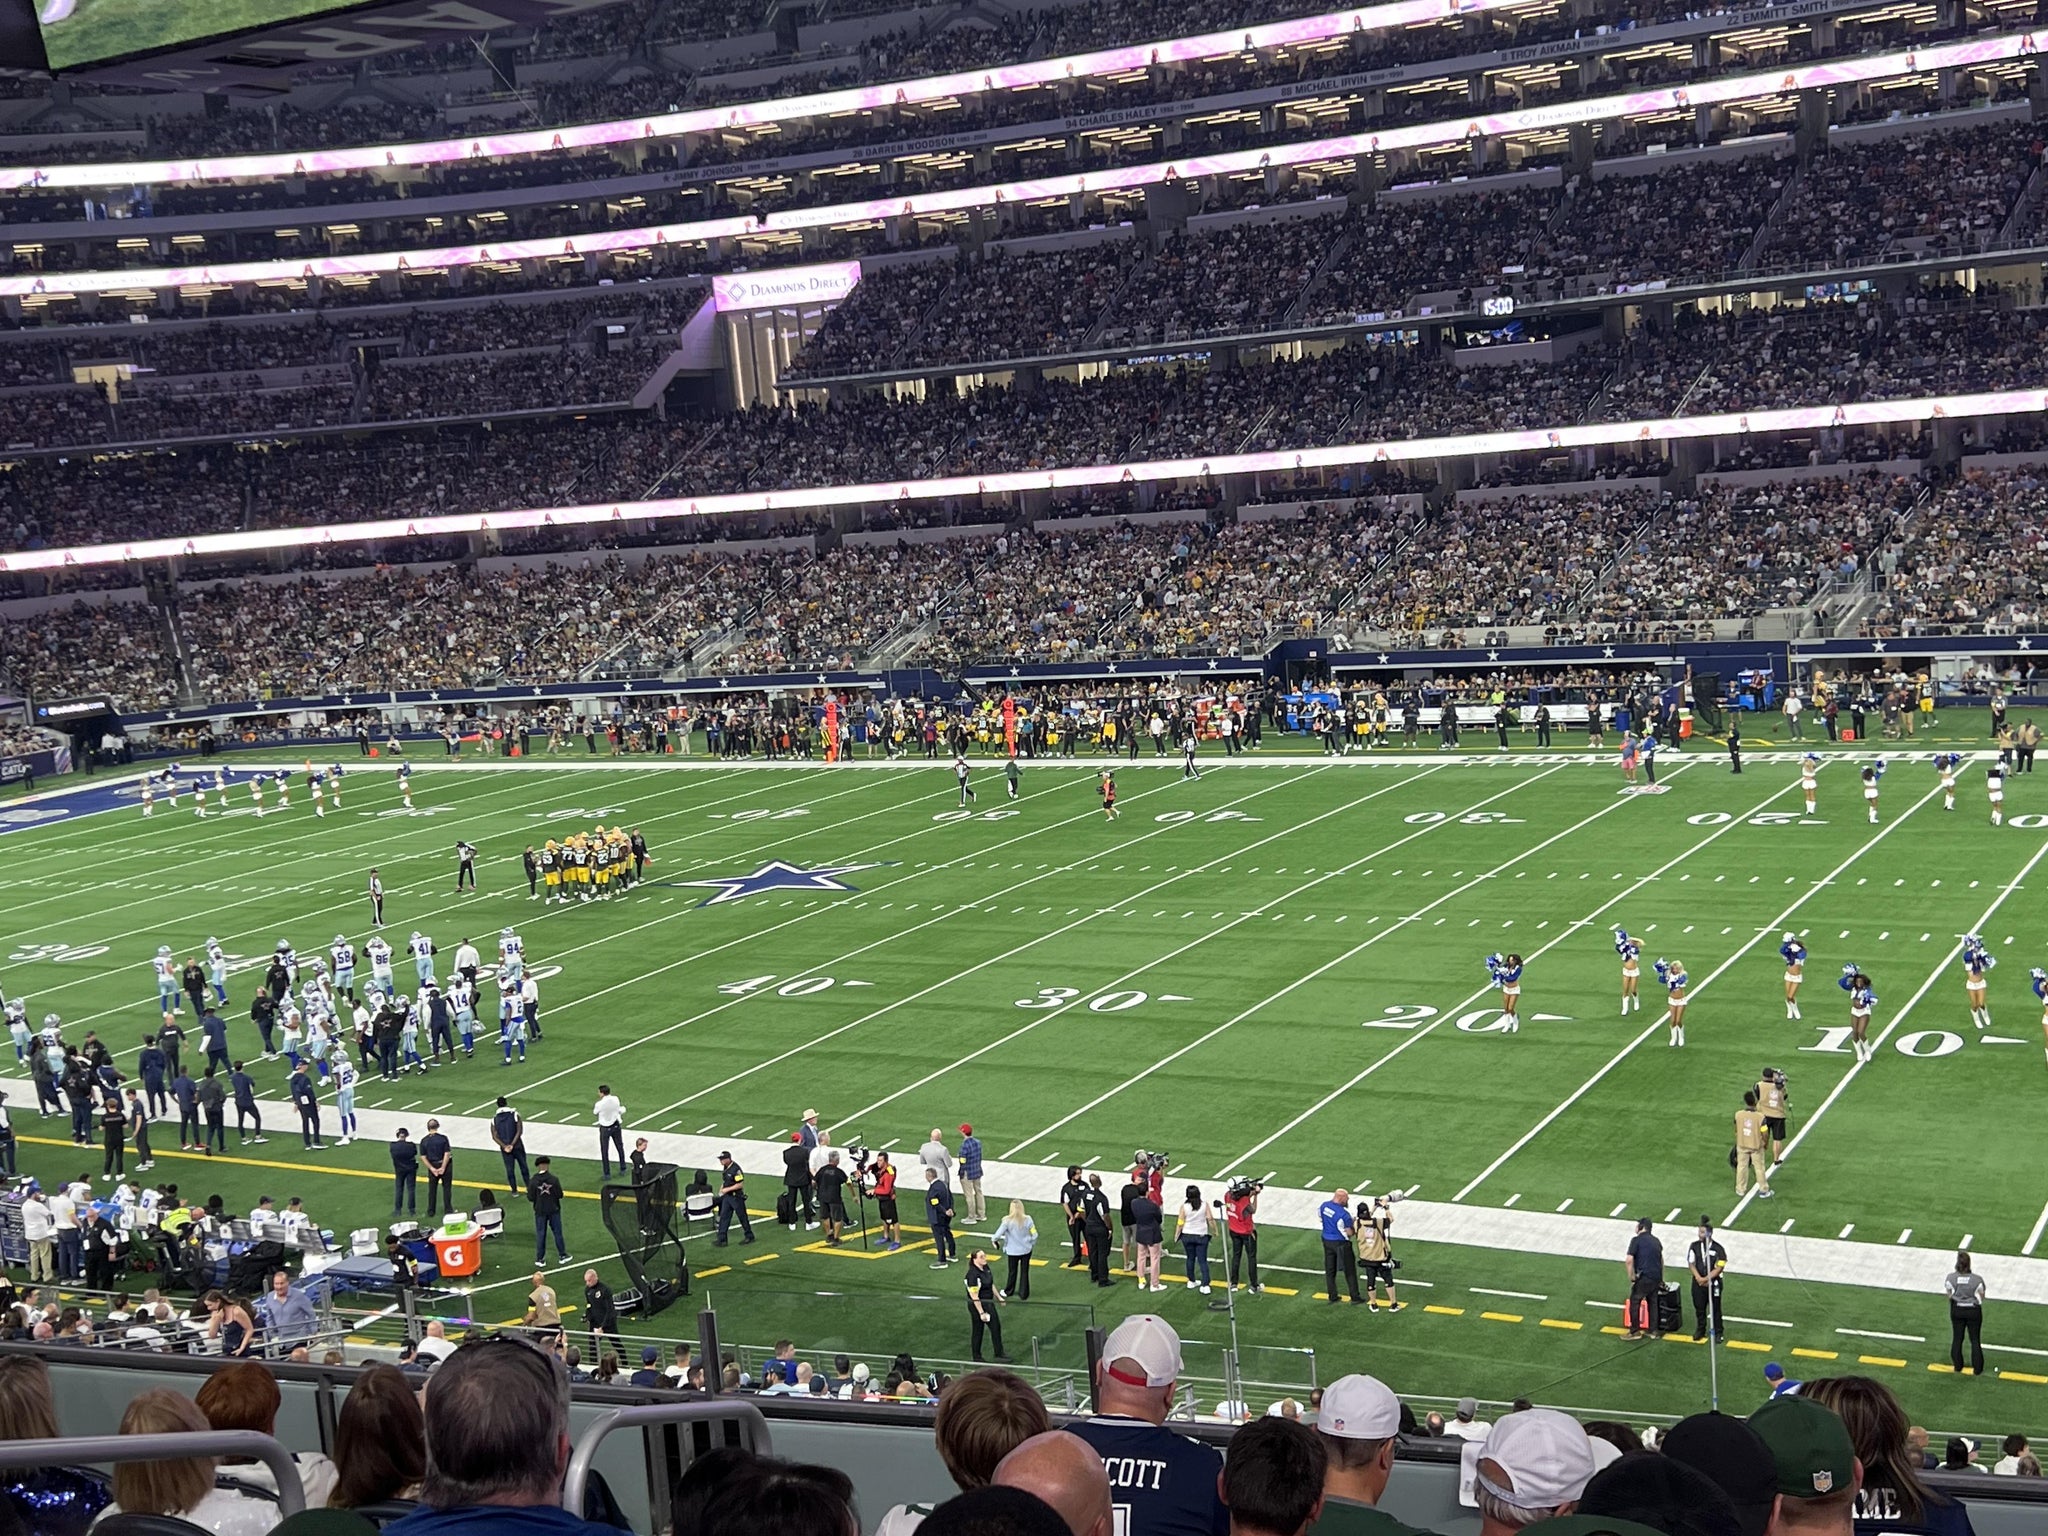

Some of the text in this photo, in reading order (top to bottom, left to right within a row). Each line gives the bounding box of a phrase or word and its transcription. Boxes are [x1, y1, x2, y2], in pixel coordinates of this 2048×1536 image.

[1726, 15, 1740, 26] 22
[1742, 7, 1788, 23] EMMITT
[1791, 0, 1828, 16] SMITH
[1510, 48, 1538, 61] TROY
[1540, 41, 1581, 56] AIKMAN
[1295, 80, 1339, 94] MICHAEL
[1341, 75, 1368, 88] IRVIN
[1065, 120, 1077, 129] 94
[1079, 113, 1124, 127] CHARLES
[1125, 107, 1157, 121] HALEY
[865, 145, 904, 157] DARREN
[907, 137, 955, 151] WOODSON
[672, 170, 699, 182] JIMMY
[701, 165, 743, 178] JOHNSON
[751, 277, 848, 297] DIAMONDS DIRECT
[1403, 811, 1508, 825] 30
[1686, 812, 1802, 826] 20
[8, 943, 111, 962] 30
[337, 950, 350, 964] 58
[418, 942, 430, 956] 41
[507, 942, 519, 955] 94
[716, 974, 838, 998] 40
[455, 993, 469, 1007] 14
[1013, 984, 1150, 1013] 30
[1360, 1003, 1510, 1033] 20
[1796, 1024, 1965, 1058] 10
[443, 1245, 464, 1267] G
[1100, 1456, 1167, 1490] COTT
